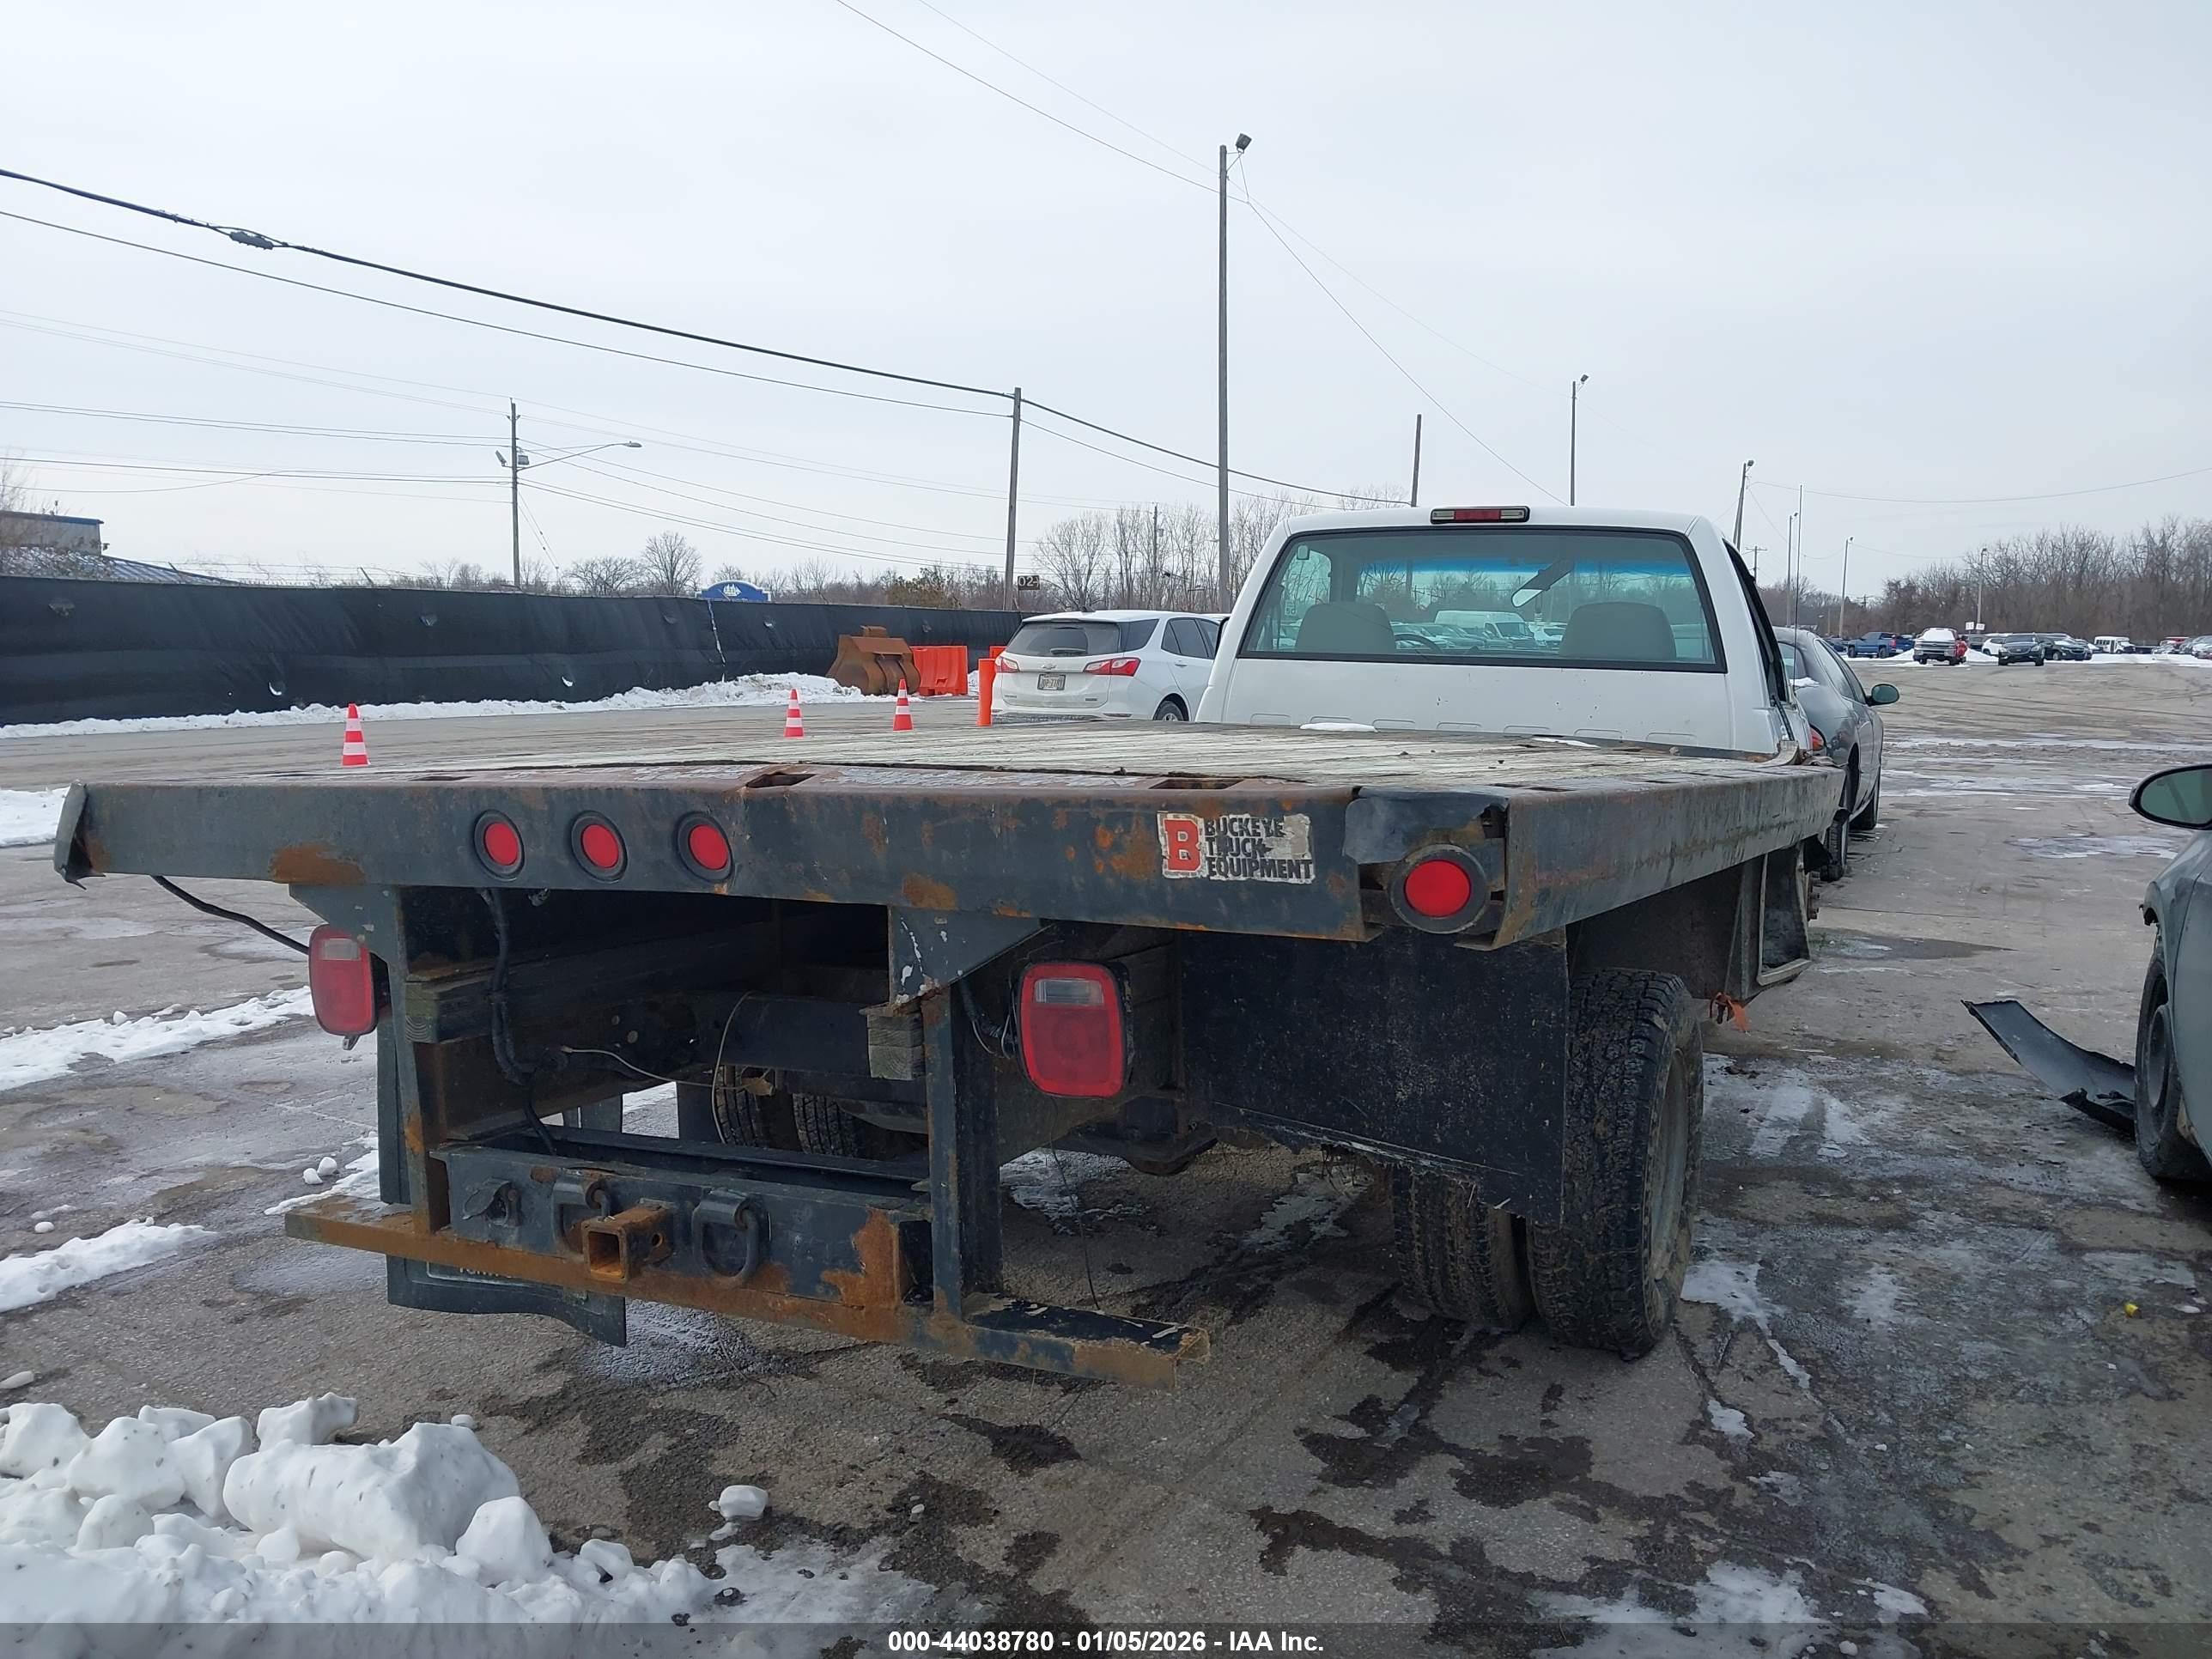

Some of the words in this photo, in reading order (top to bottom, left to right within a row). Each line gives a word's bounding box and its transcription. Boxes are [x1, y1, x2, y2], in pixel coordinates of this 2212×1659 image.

[1204, 817, 1286, 837] BUCKEYE
[1164, 818, 1201, 872] B
[1206, 856, 1312, 879] EQUIPMENT
